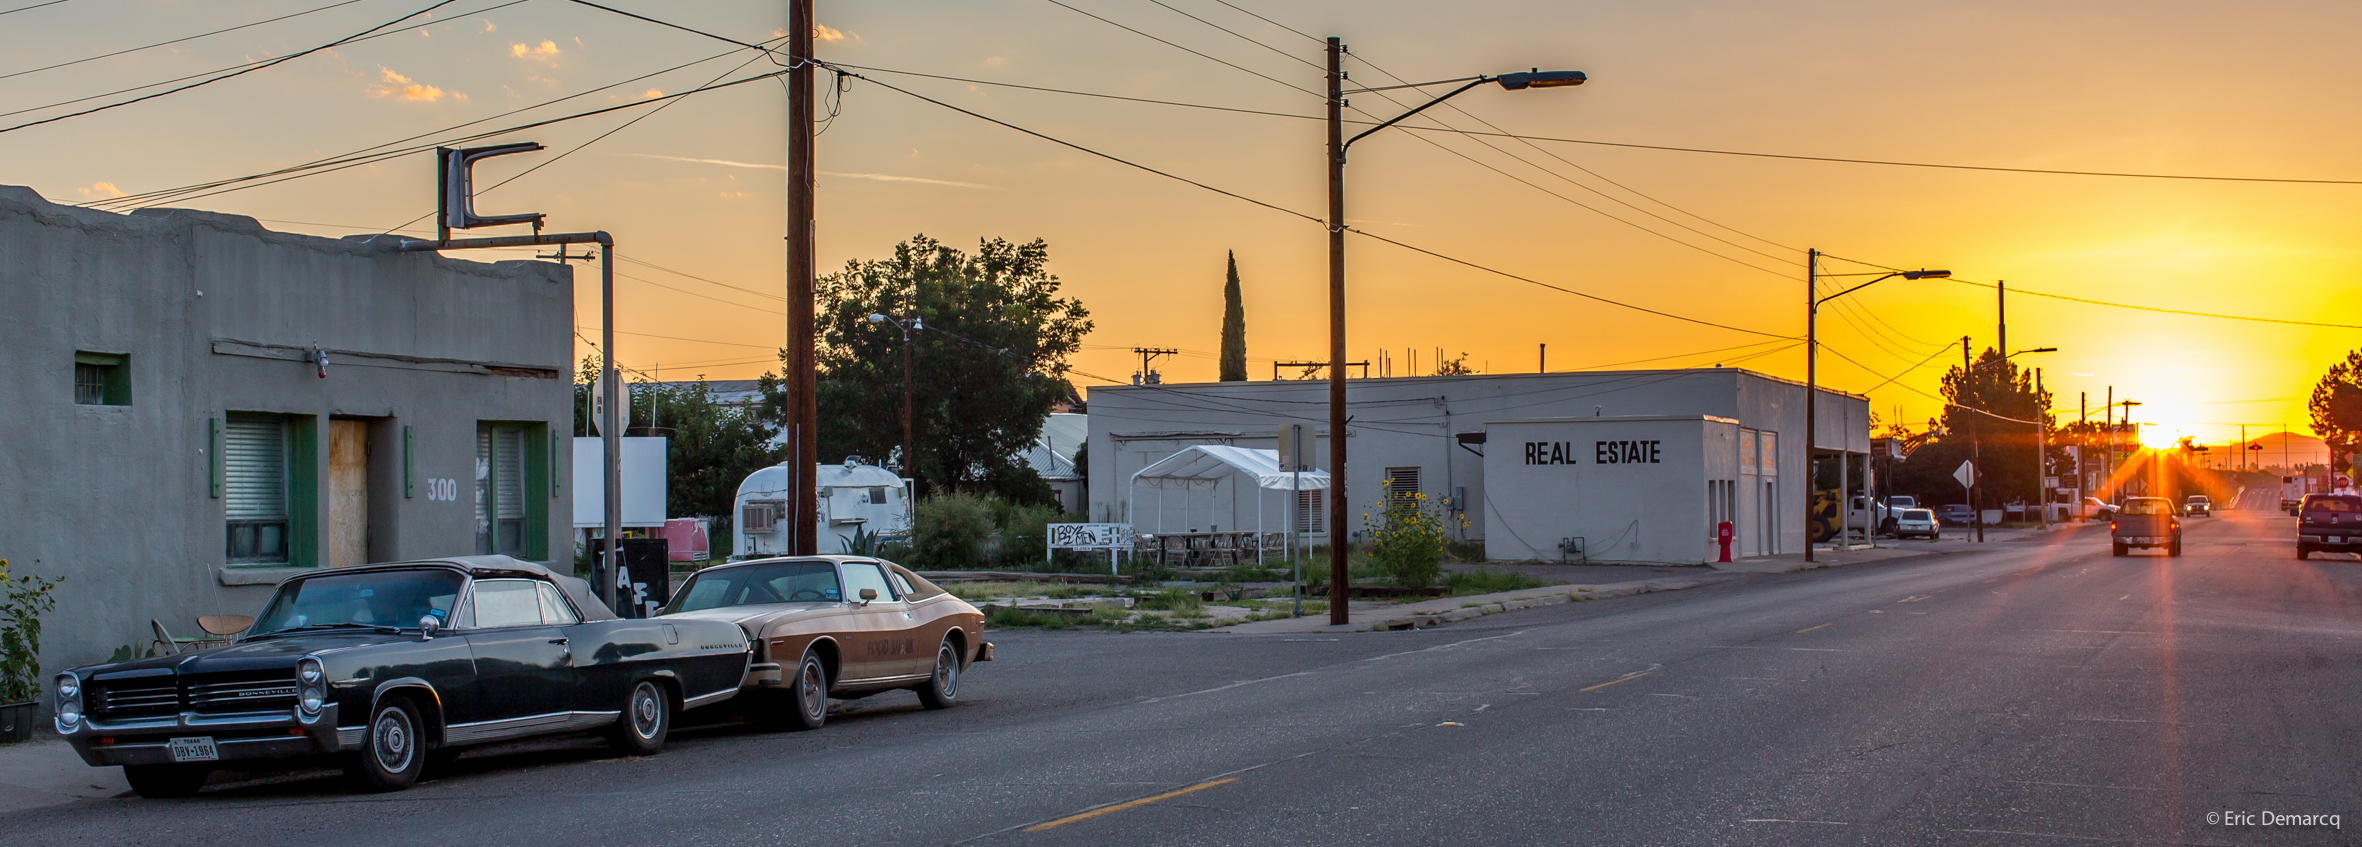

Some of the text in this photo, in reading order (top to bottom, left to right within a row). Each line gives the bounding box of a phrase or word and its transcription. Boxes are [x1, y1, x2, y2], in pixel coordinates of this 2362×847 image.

[1525, 440, 1661, 465] REAL ESTATE
[427, 478, 457, 501] 300
[1057, 525, 1083, 541] BOYZ
[1075, 529, 1097, 546] MEN
[867, 639, 889, 656] FOOD
[238, 688, 297, 697] BONNEVILLE
